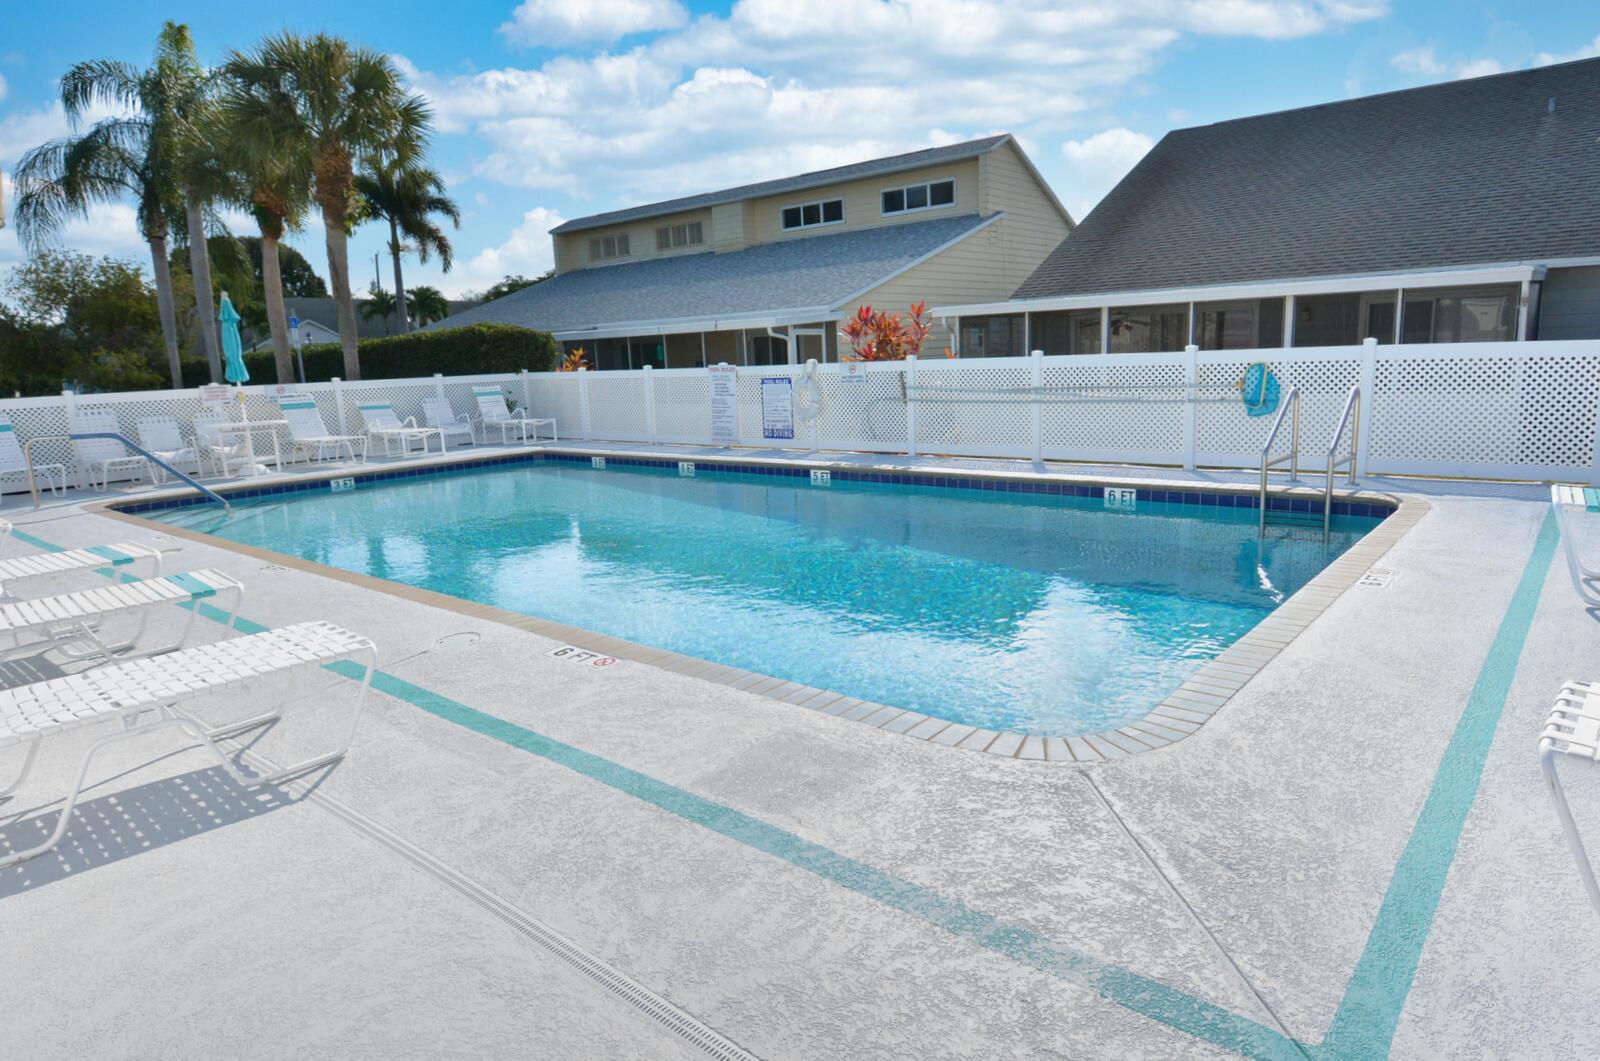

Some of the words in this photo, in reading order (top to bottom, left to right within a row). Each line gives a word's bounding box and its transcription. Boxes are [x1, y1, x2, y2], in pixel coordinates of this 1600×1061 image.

[765, 429, 772, 438] NO
[773, 429, 793, 438] DIVING
[554, 648, 575, 656] 6
[567, 652, 598, 662] FT
